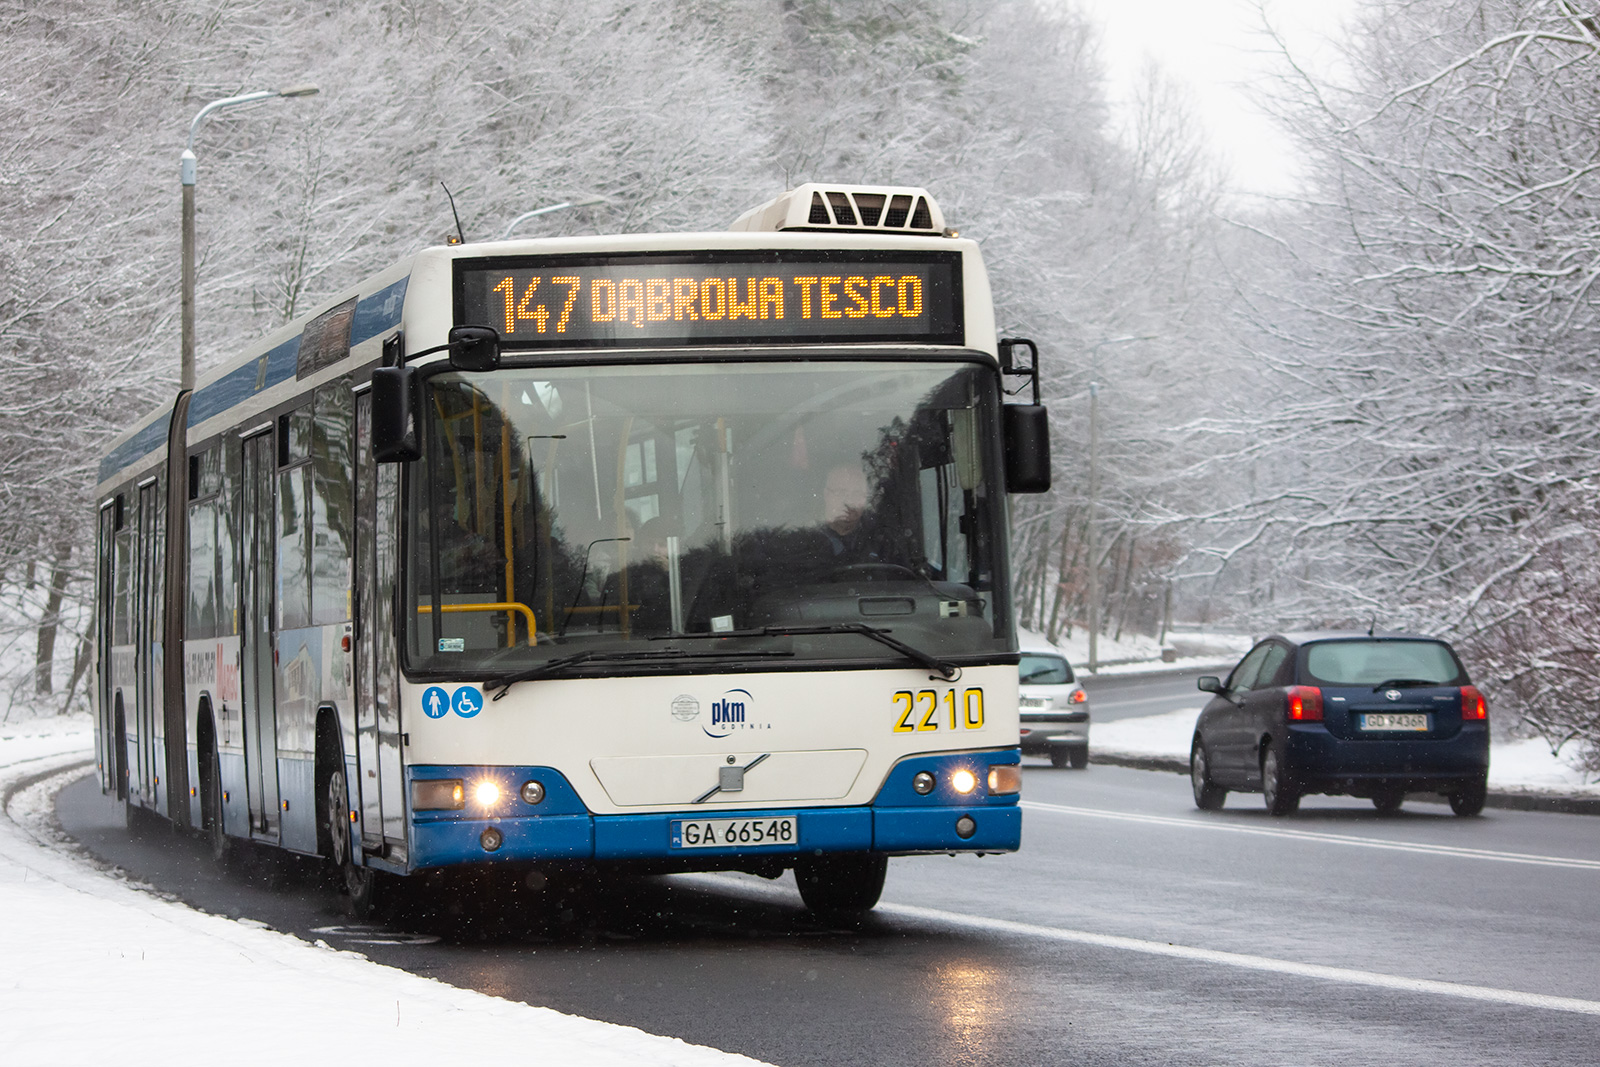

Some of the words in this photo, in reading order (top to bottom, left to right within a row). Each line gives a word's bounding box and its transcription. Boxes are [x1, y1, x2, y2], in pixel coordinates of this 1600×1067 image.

[493, 276, 580, 333] 147
[591, 276, 784, 328] DĄBROWA
[794, 275, 922, 318] TESCO
[712, 698, 745, 725] pkm
[892, 687, 984, 732] 2210
[1367, 714, 1385, 727] GD
[1388, 714, 1425, 727] 9436R
[685, 823, 716, 845] GA
[725, 820, 792, 843] 66548
